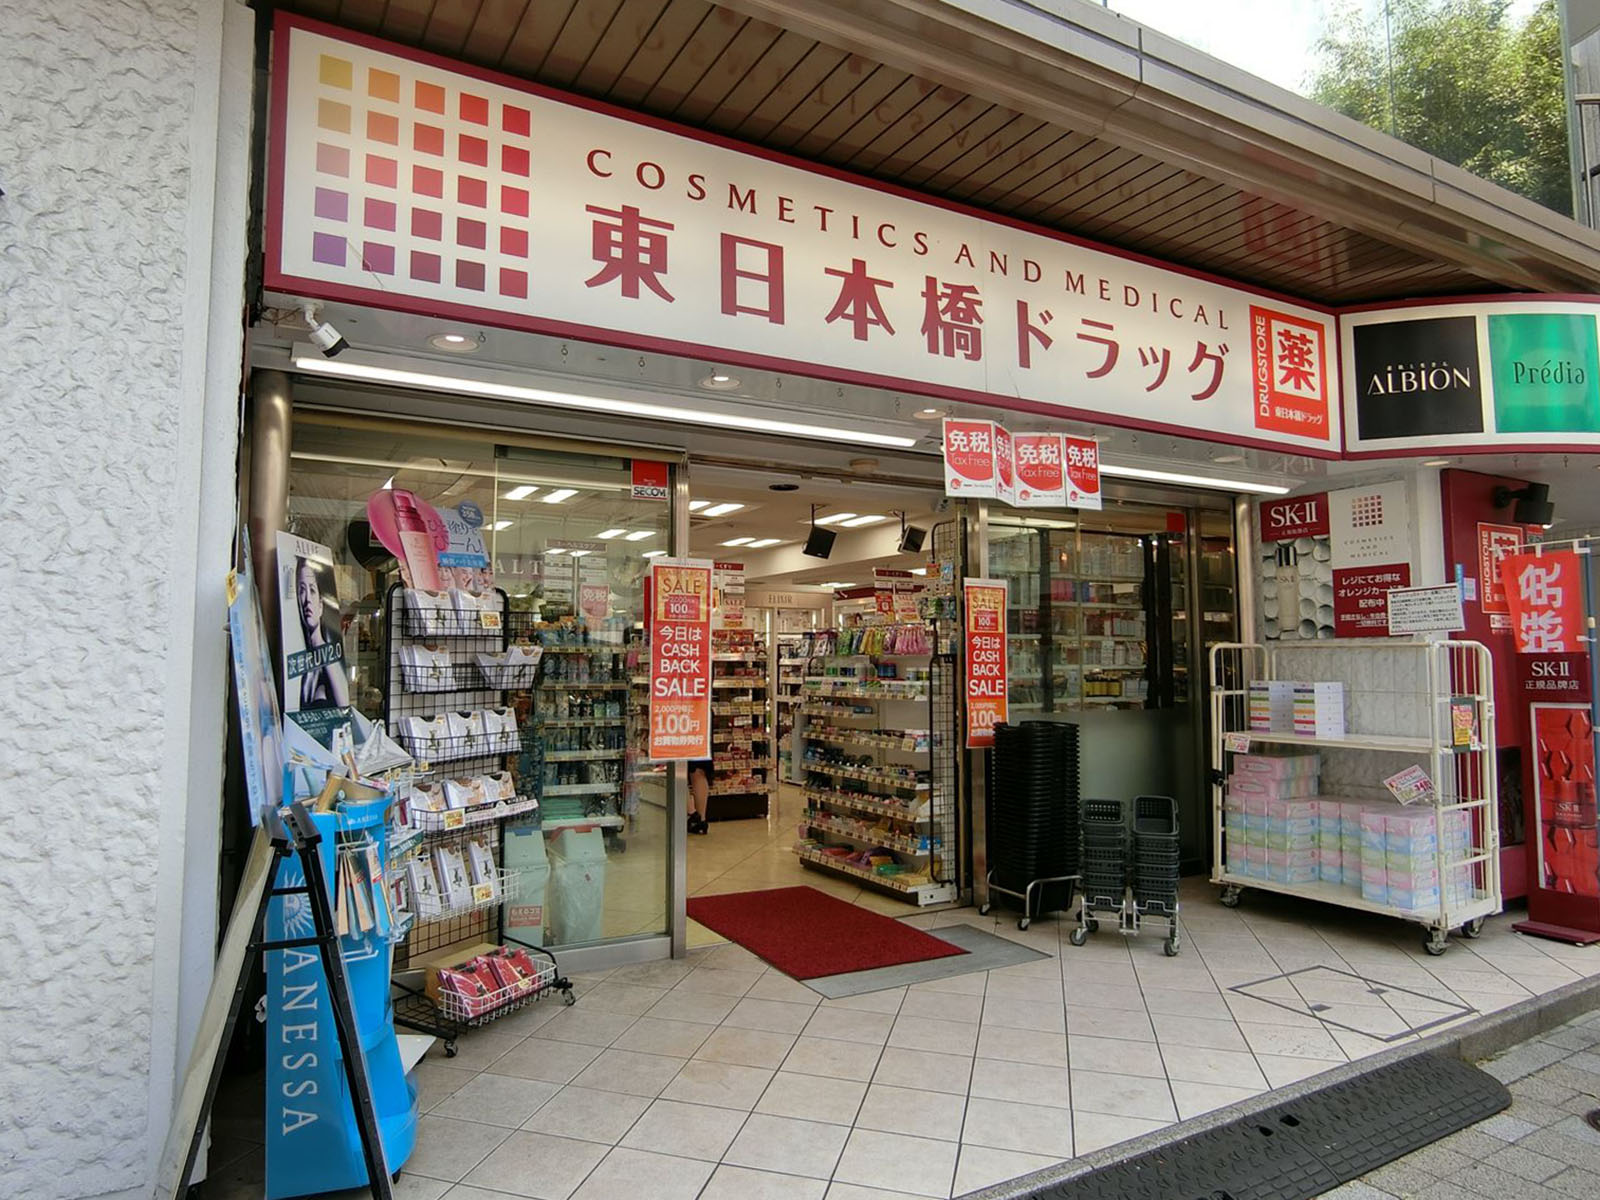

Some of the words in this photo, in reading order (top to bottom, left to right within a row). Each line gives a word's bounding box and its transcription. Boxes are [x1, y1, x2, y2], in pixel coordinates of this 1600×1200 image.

[586, 148, 930, 256] COSMETICS
[954, 243, 1042, 283] AND
[1065, 270, 1229, 330] MEDICAL
[584, 203, 1230, 401] 東日本橋ドラッグ
[1255, 314, 1270, 417] DRUGSTORE
[1277, 328, 1316, 392] 薬
[1367, 366, 1471, 395] ALBION
[1513, 359, 1585, 385] Prédia
[949, 429, 991, 454] 免税
[951, 454, 967, 466] Tax
[968, 454, 990, 467] Free
[1017, 443, 1060, 465] 免税
[1067, 446, 1097, 469] 免税
[1020, 466, 1037, 478] Tax
[1038, 466, 1060, 479] Free
[633, 486, 667, 498] SECOM
[1270, 500, 1318, 528] SK-II
[662, 578, 702, 594] SALE
[670, 603, 688, 613] 100
[972, 596, 999, 610] SALE
[659, 626, 702, 641] 今日は
[660, 642, 700, 657] CASH
[971, 636, 1001, 650] 今日は
[973, 650, 1000, 663] CASH
[660, 659, 701, 674] BACK
[972, 663, 1001, 677] BACK
[1531, 661, 1570, 677] SK-II
[654, 677, 706, 698] SALE
[969, 679, 1004, 696] SALE
[655, 714, 700, 734] 100円
[282, 948, 319, 1136] ANESSA
